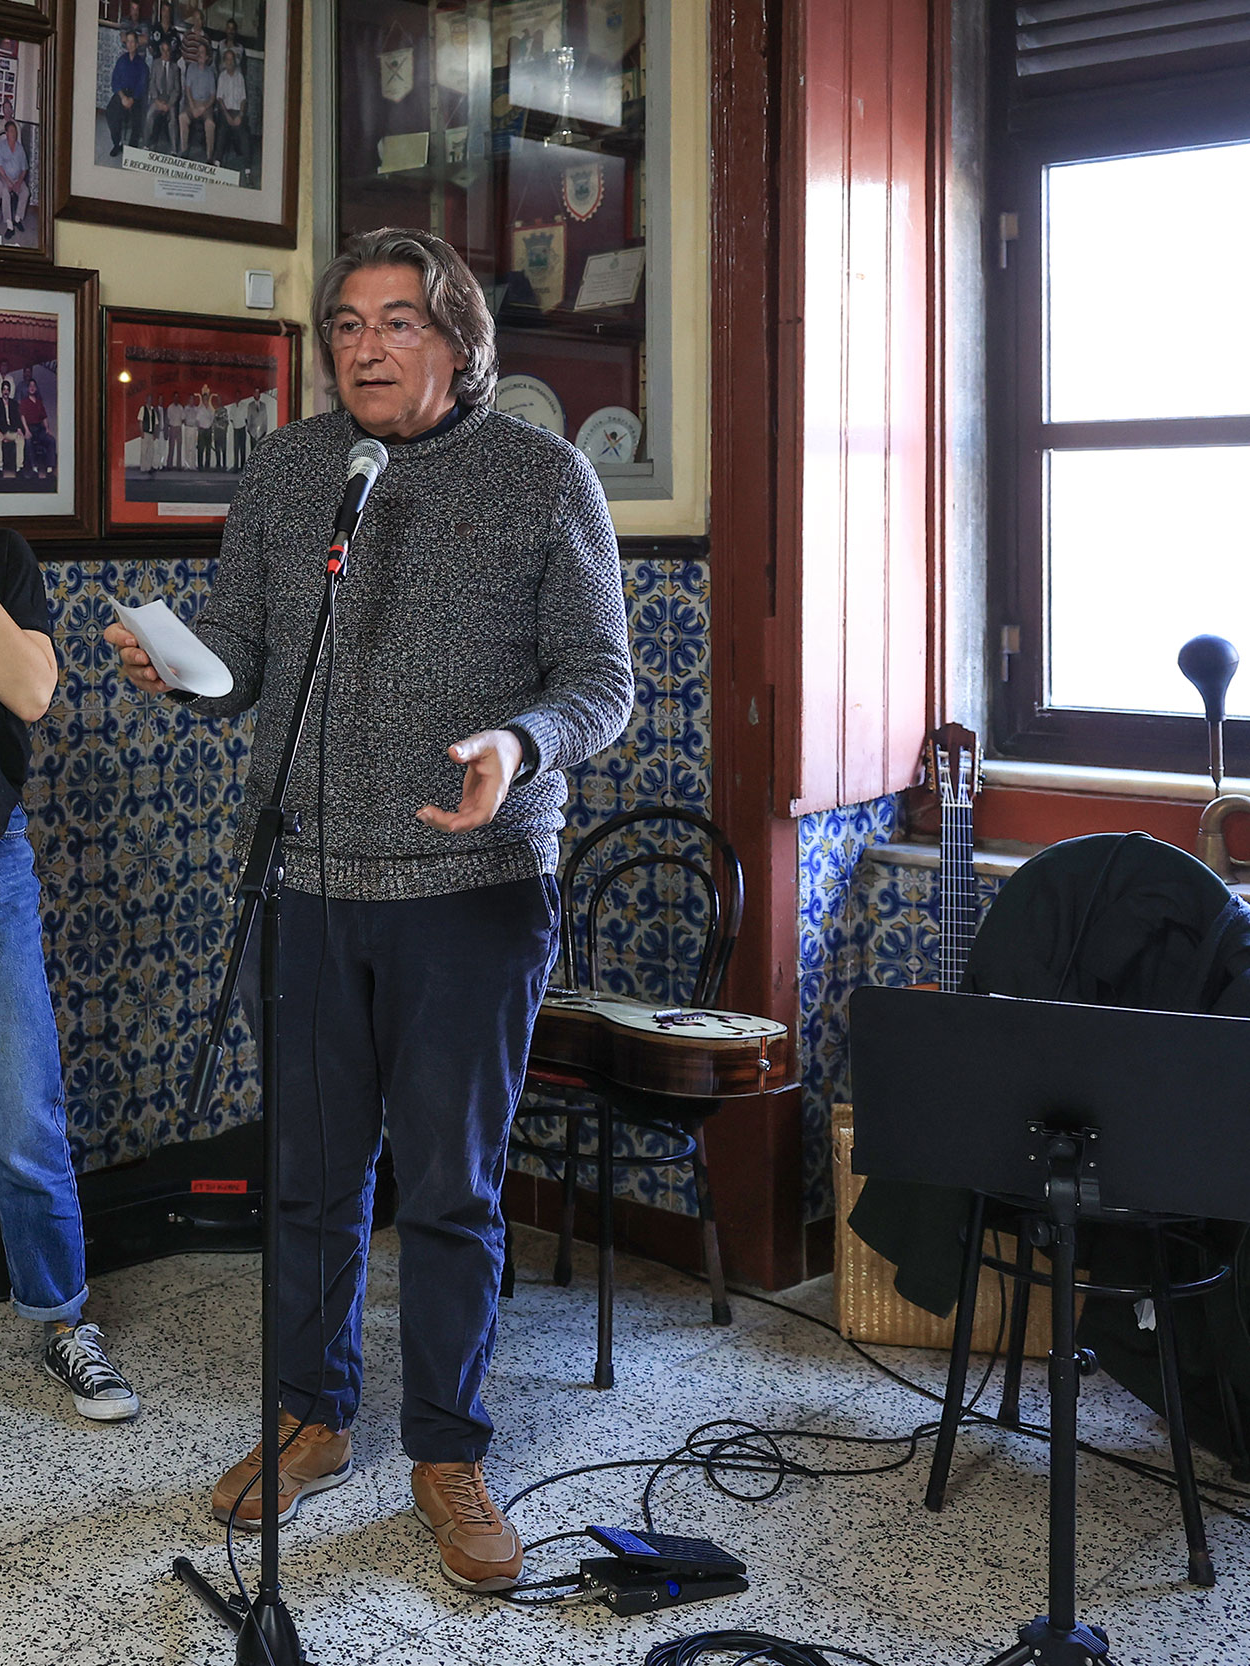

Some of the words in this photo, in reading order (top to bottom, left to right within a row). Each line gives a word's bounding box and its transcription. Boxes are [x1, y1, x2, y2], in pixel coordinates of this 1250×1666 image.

[129, 159, 170, 177] RECREATIVA
[148, 152, 187, 168] SOCIEDADE
[188, 161, 217, 175] MUSICAL
